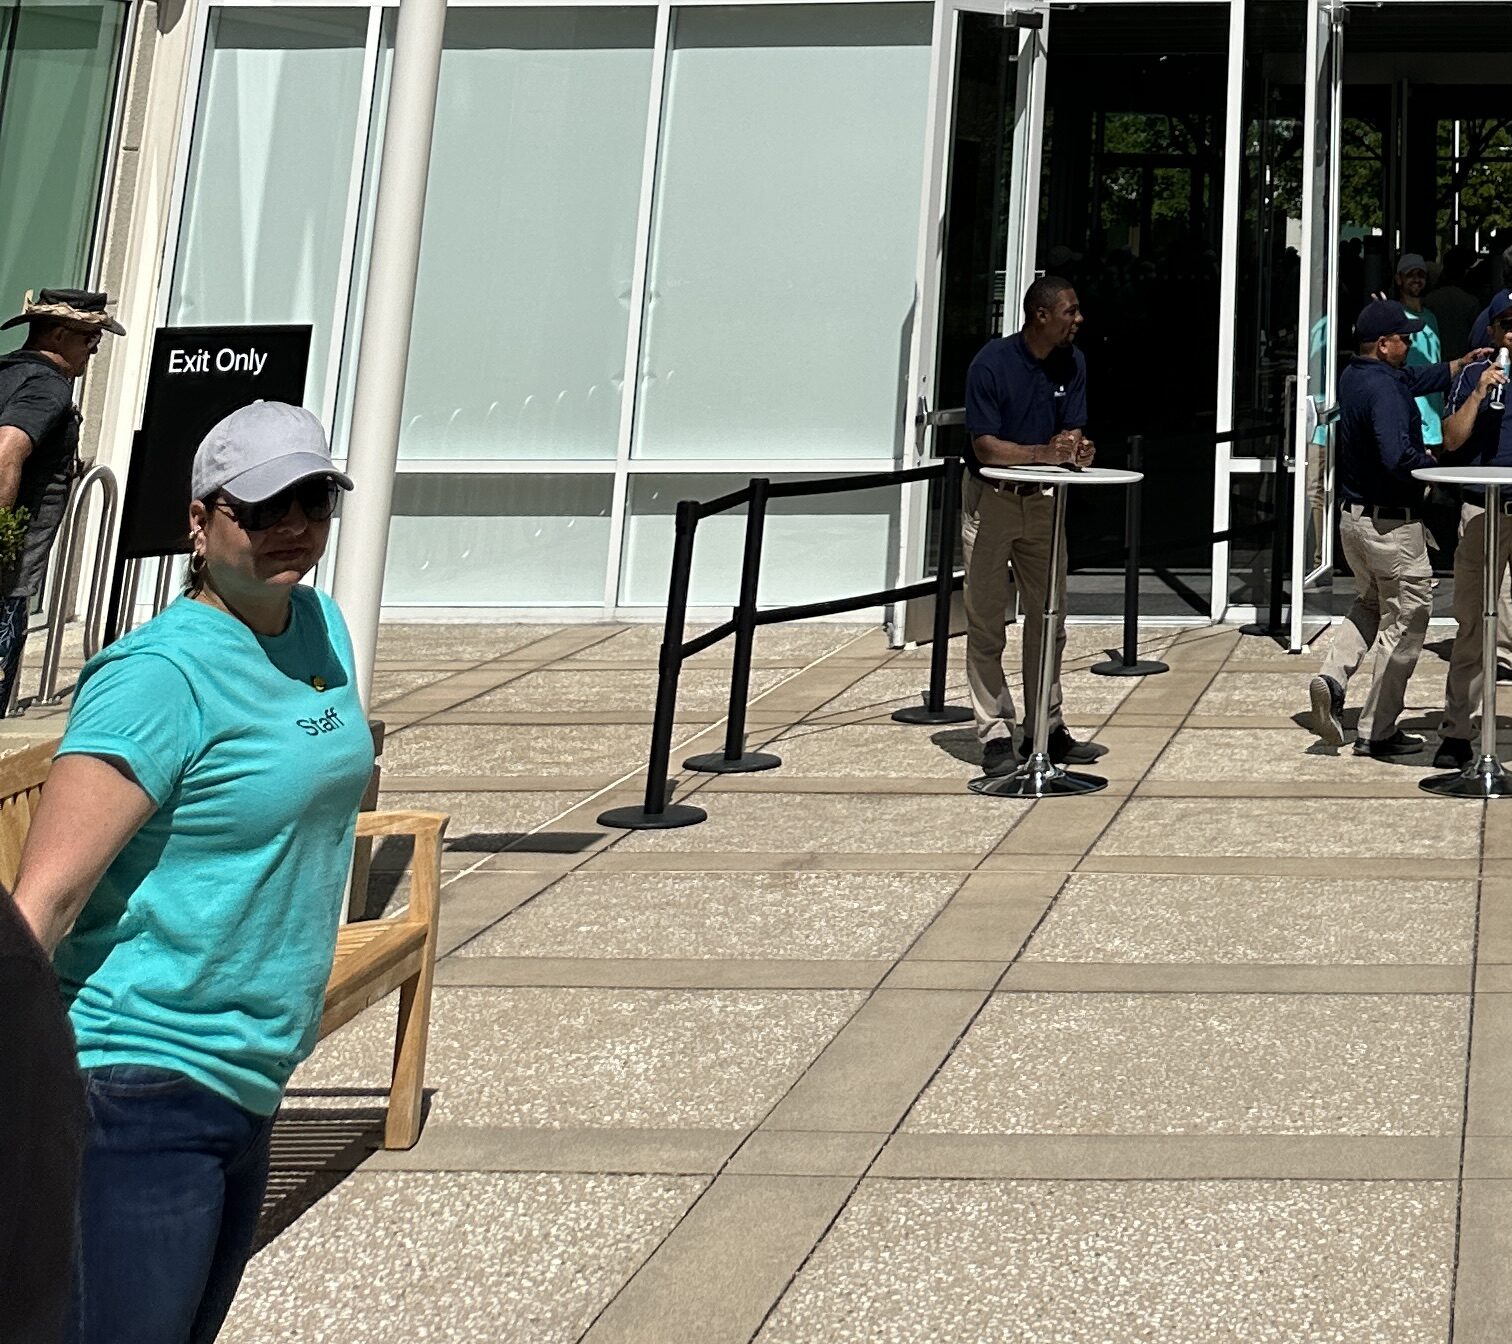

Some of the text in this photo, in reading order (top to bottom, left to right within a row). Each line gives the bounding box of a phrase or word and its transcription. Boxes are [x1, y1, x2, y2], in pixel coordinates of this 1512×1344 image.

[168, 347, 268, 376] Exit Only
[296, 706, 345, 736] Staff
